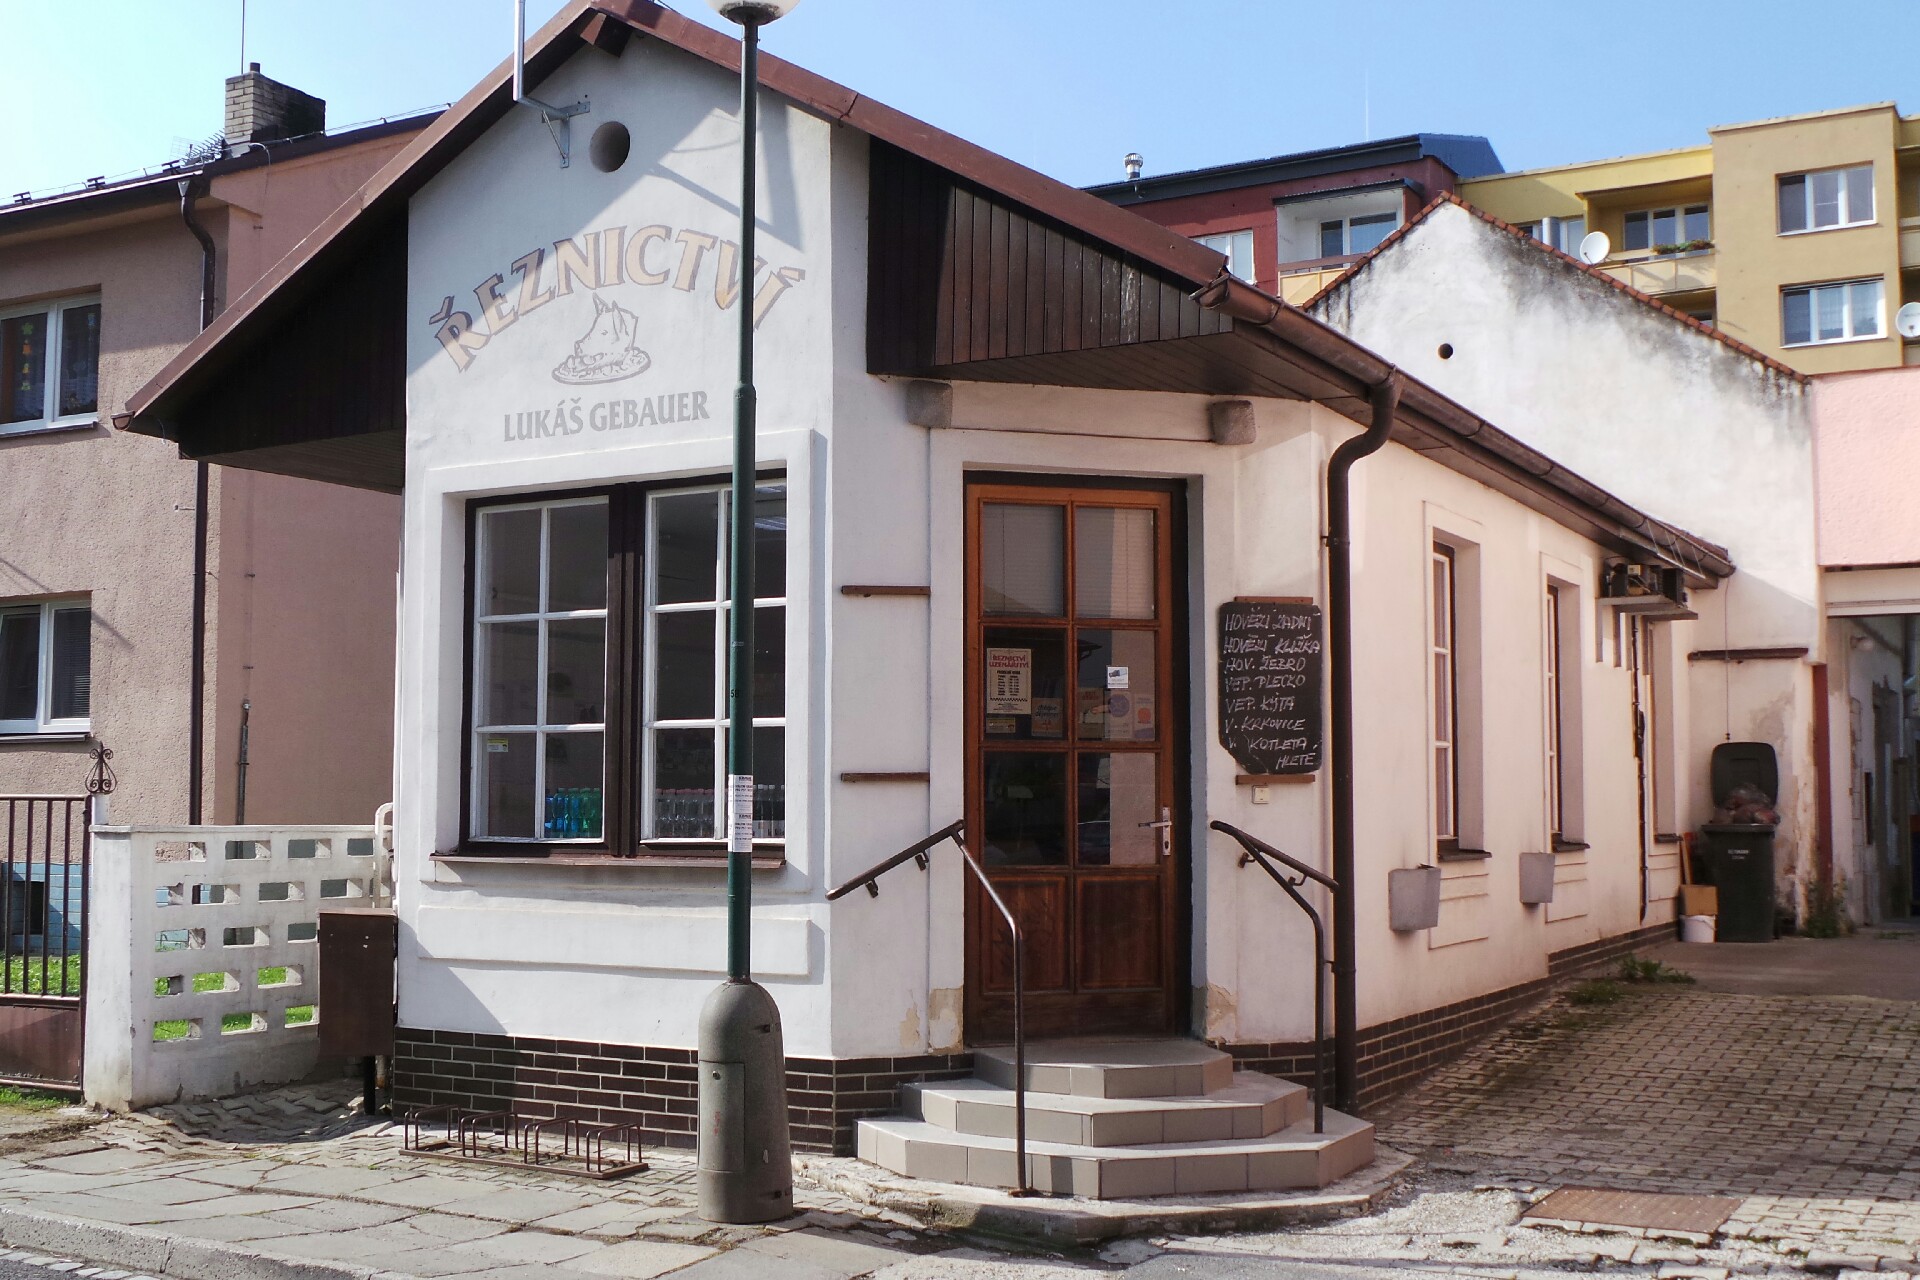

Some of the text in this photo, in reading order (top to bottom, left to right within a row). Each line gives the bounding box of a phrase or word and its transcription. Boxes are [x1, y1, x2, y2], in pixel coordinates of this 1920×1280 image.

[429, 225, 805, 372] ŘEZNICTVÍ
[504, 391, 710, 442] LUKÁŠ GEBAUER
[1225, 658, 1255, 671] HOV.
[1225, 696, 1255, 713] VEP.
